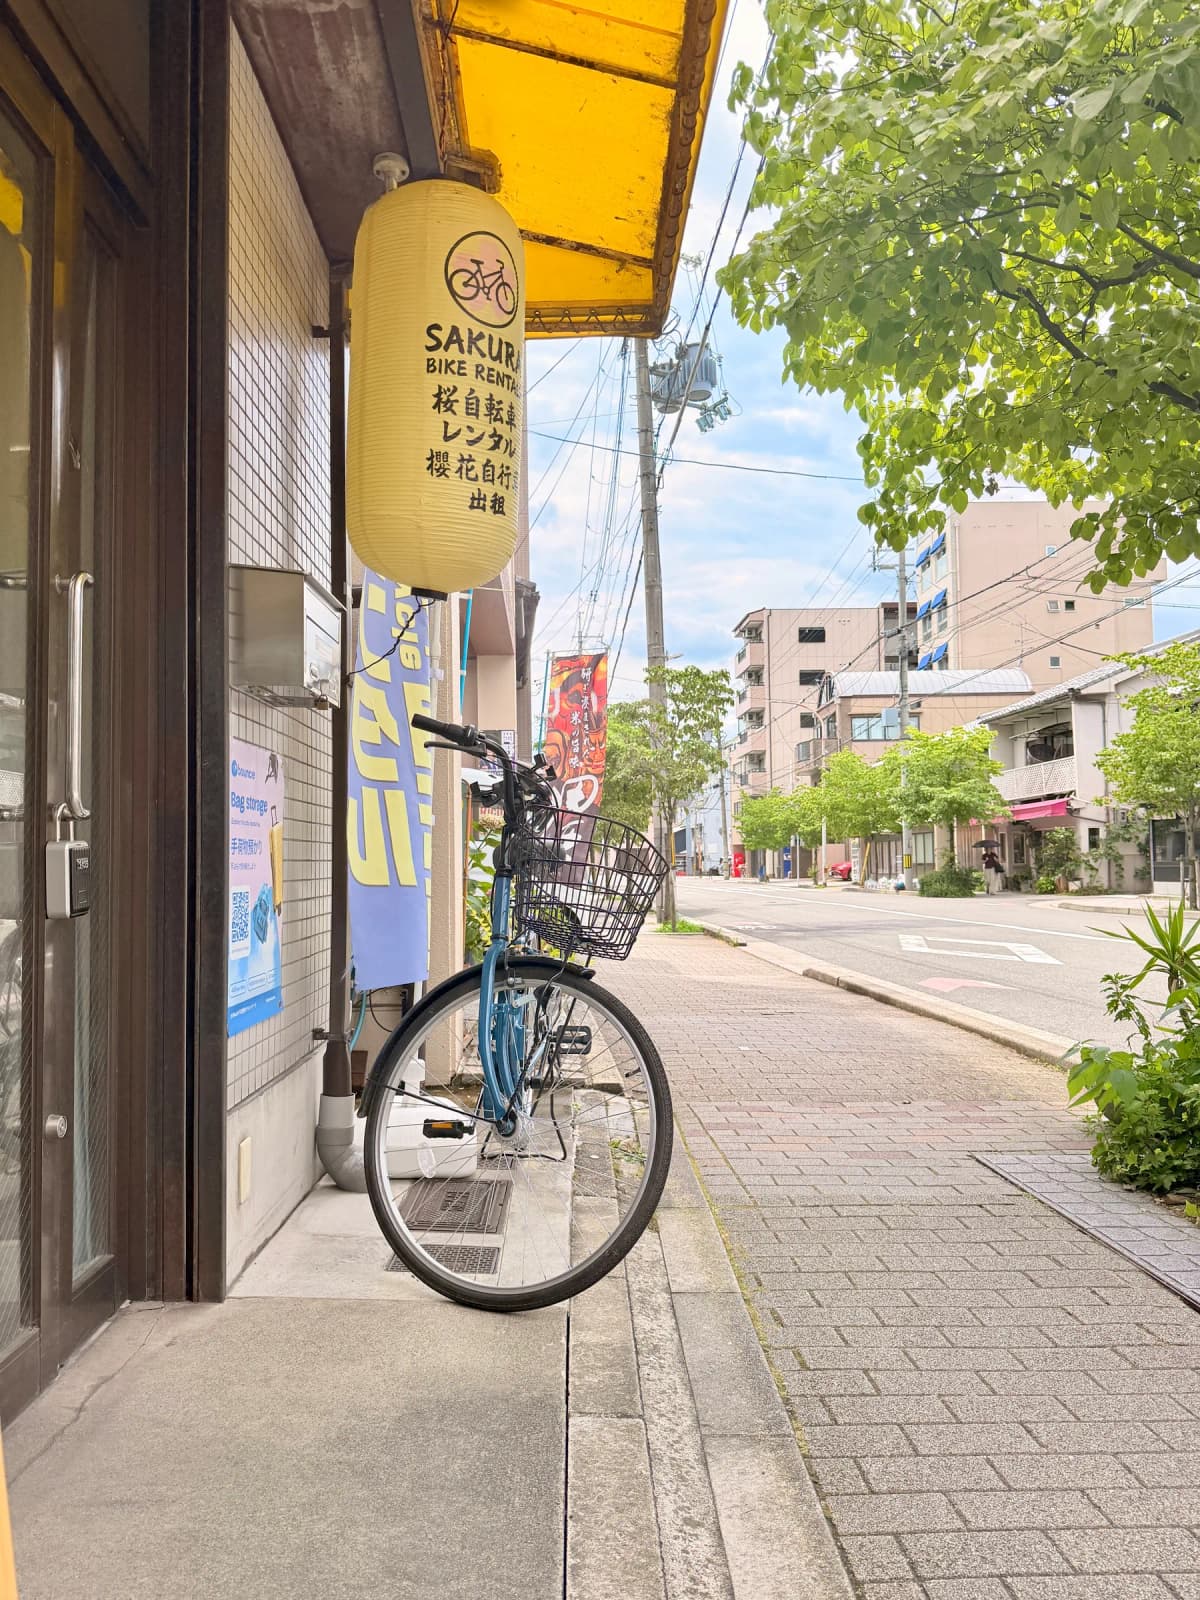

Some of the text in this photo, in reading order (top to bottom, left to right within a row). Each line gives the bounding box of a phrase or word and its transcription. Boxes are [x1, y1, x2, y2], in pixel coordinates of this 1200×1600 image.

[426, 357, 467, 376] BIKE
[432, 384, 516, 432] 桜自転車
[443, 420, 516, 458] レンタル
[468, 488, 505, 516] 出租
[231, 792, 268, 816] Bag storage
